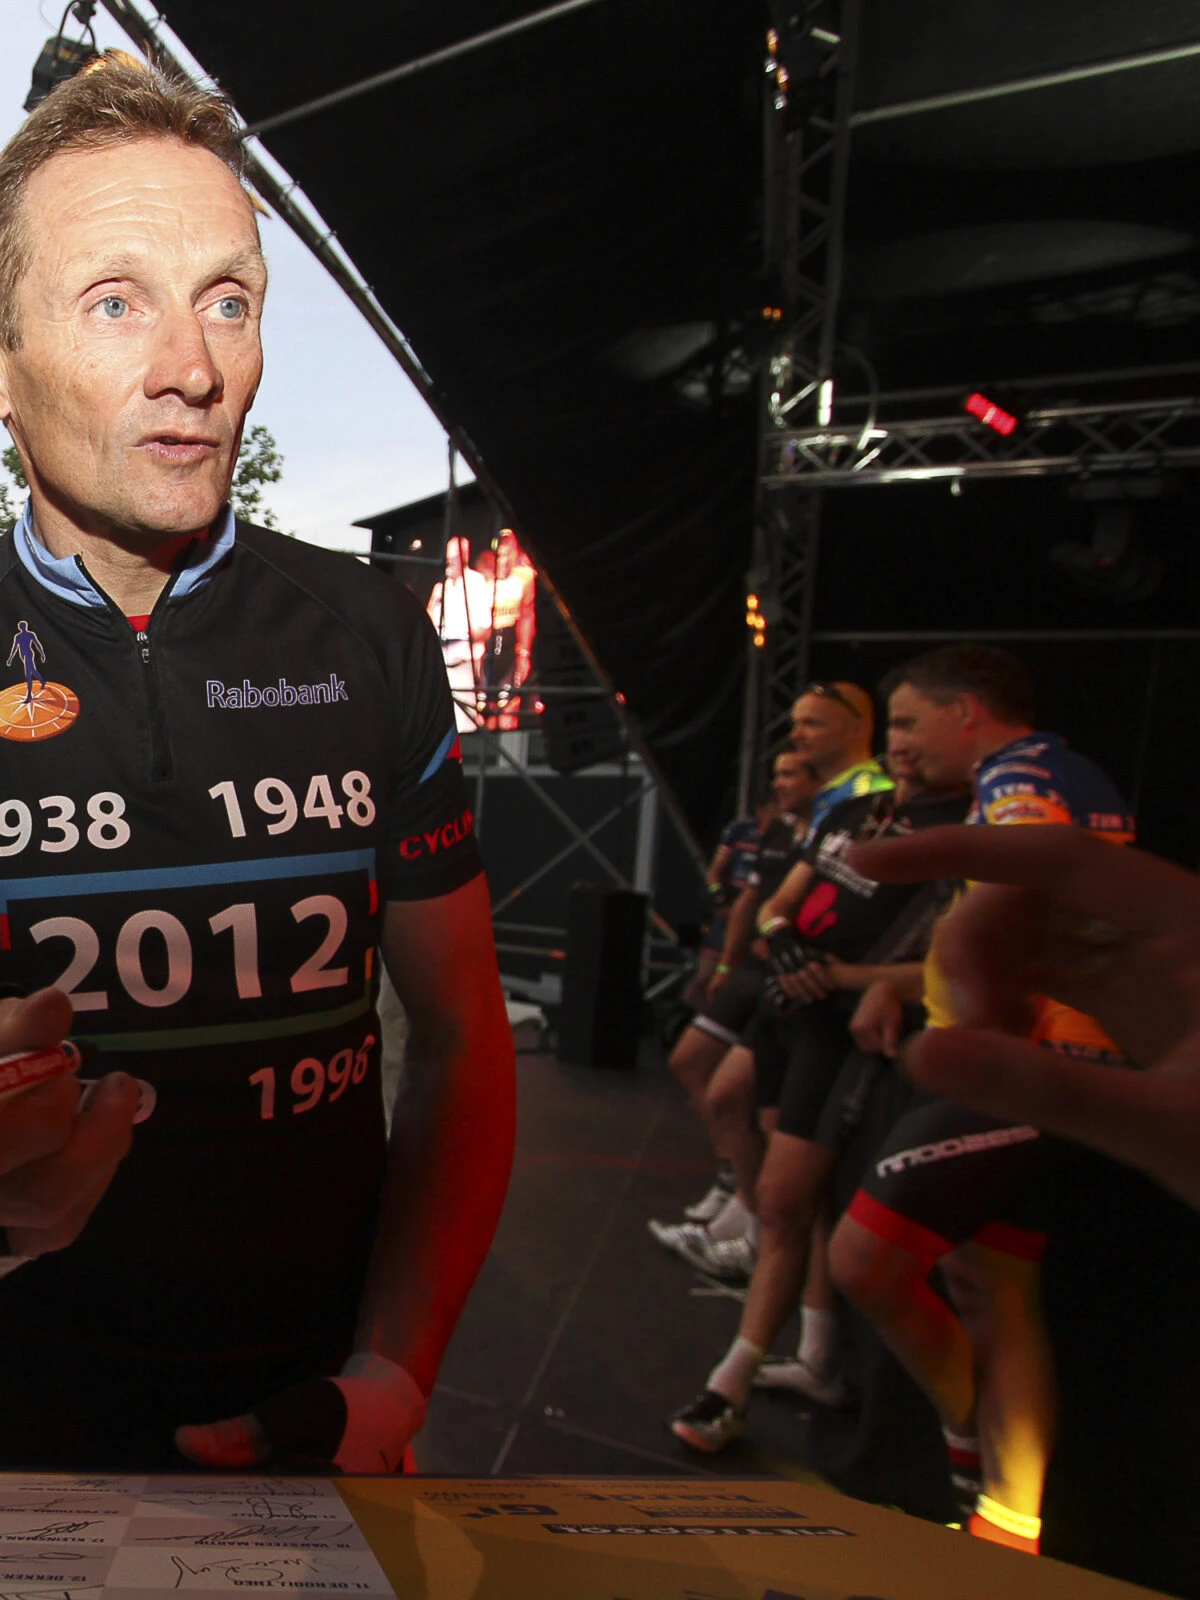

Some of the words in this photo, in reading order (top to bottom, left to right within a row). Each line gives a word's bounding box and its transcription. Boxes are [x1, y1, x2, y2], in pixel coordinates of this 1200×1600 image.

[204, 673, 349, 710] Rabobank
[208, 769, 378, 839] 1948
[29, 894, 352, 1013] 2012
